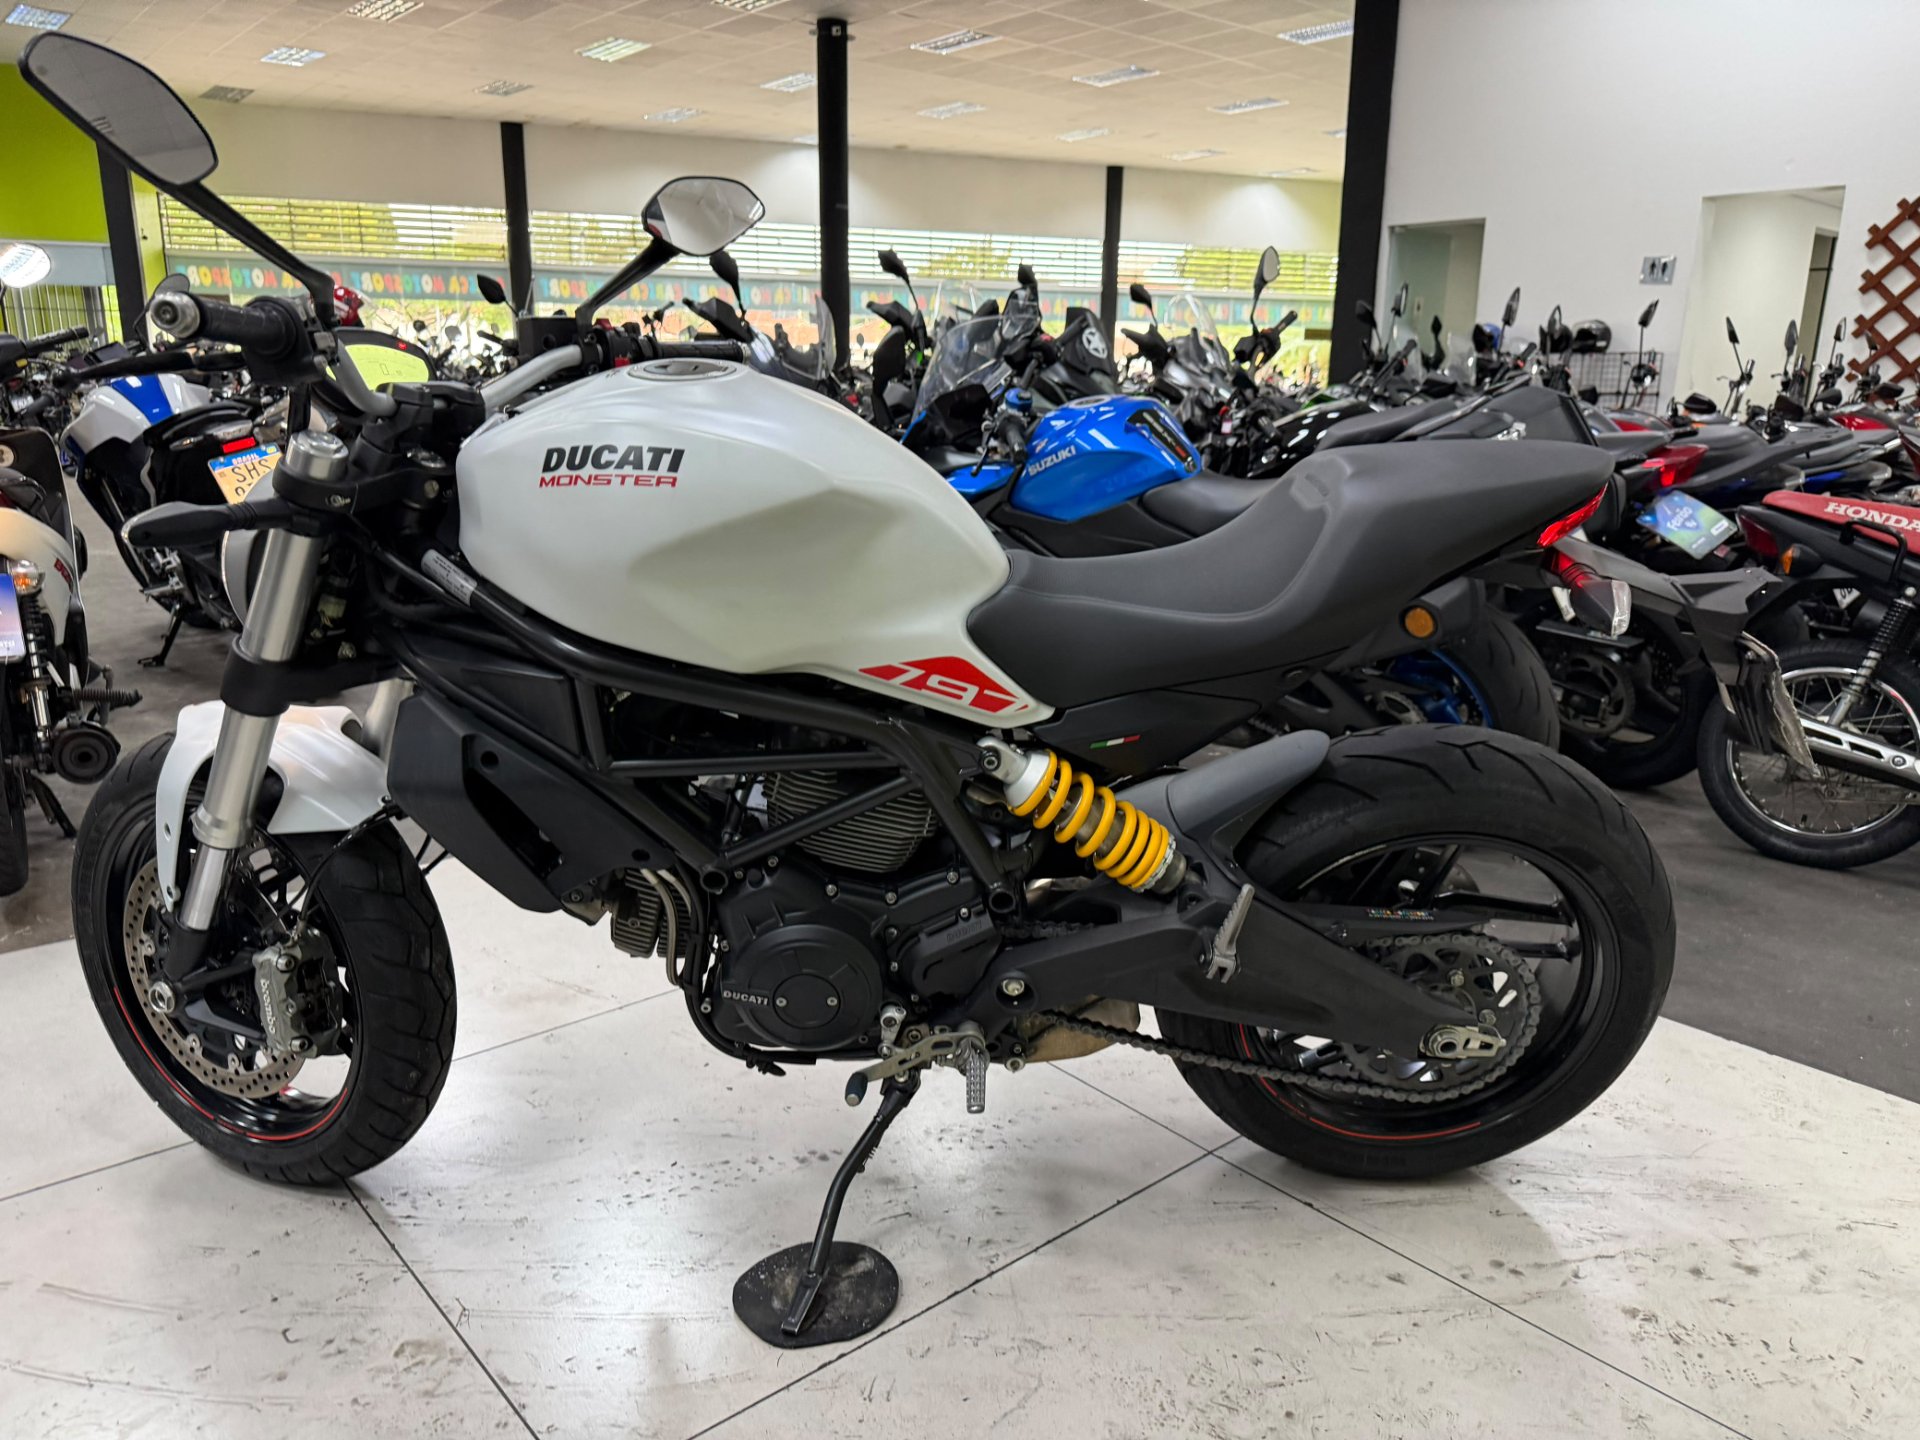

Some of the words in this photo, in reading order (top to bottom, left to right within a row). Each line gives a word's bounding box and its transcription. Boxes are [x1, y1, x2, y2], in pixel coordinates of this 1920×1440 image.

[541, 444, 685, 474] DUCATI
[1027, 444, 1078, 477] SUZUKI
[538, 473, 678, 489] MONSTER
[1823, 501, 1920, 533] HONDA
[259, 978, 277, 1035] brembo
[722, 988, 769, 1006] DUCATI
